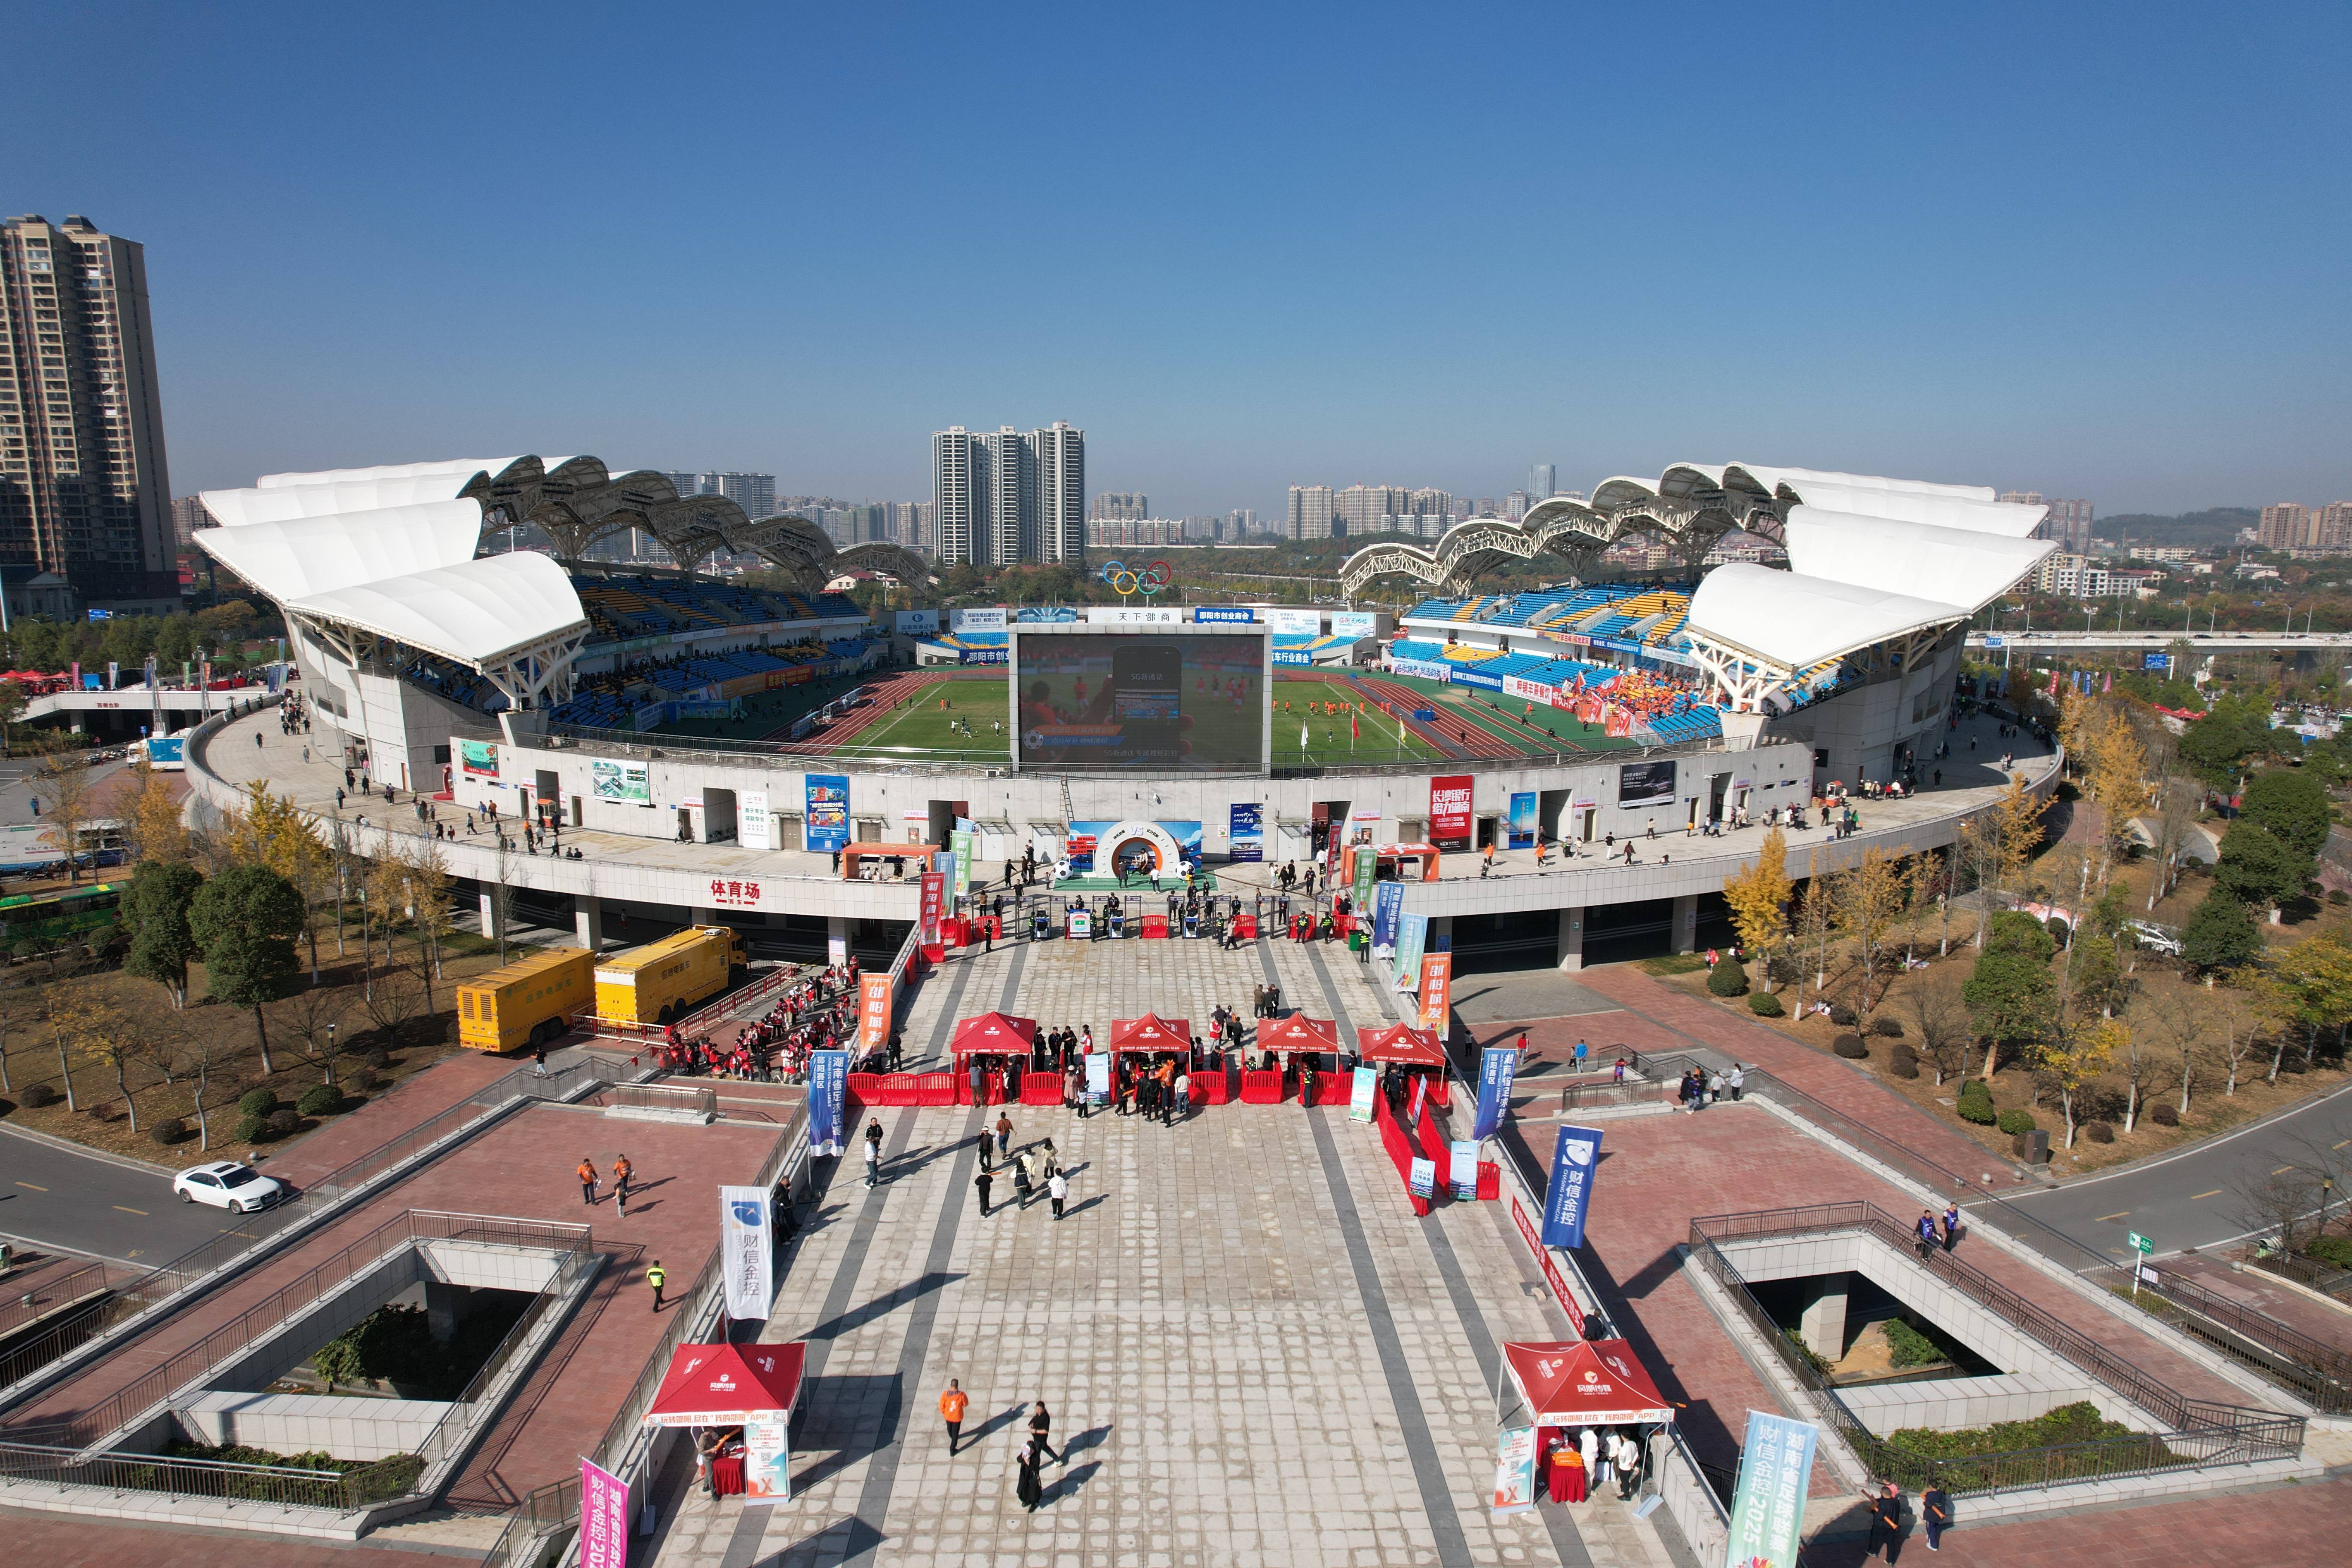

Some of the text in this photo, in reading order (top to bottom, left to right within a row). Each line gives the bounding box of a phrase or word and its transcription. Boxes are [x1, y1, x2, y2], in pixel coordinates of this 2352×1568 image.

[1119, 613, 1170, 622] 天下邵商
[1200, 612, 1250, 620] 邵阳市创业商会
[1432, 789, 1471, 802] 长沙银行
[1432, 801, 1470, 817] 给力湖南
[1130, 826, 1144, 836] VS
[710, 879, 760, 899] 体育场
[926, 882, 939, 925] 湘超湘味
[662, 959, 691, 980] 应急电源车
[526, 977, 572, 1004] 应急电源车
[1427, 965, 1444, 1019] 邵阳城发
[867, 986, 885, 1042] 邵阳城发
[817, 1056, 825, 1089] 邵阳赛区
[1488, 1054, 1499, 1084] 邵阳赛区
[832, 1057, 845, 1136] 湖南省足球联赛
[1495, 1054, 1514, 1129] 湖南省足球联赛
[1554, 1169, 1568, 1223] CHASING FINANCIAL
[1560, 1170, 1585, 1226] 财信金控
[743, 1234, 760, 1296] 财信金控
[1577, 1384, 1613, 1393] 风帆传媒
[1743, 1425, 1780, 1546] 财信金控 2025
[1769, 1431, 1806, 1554] 湖南省足球联赛
[591, 1474, 606, 1541] 财信金控
